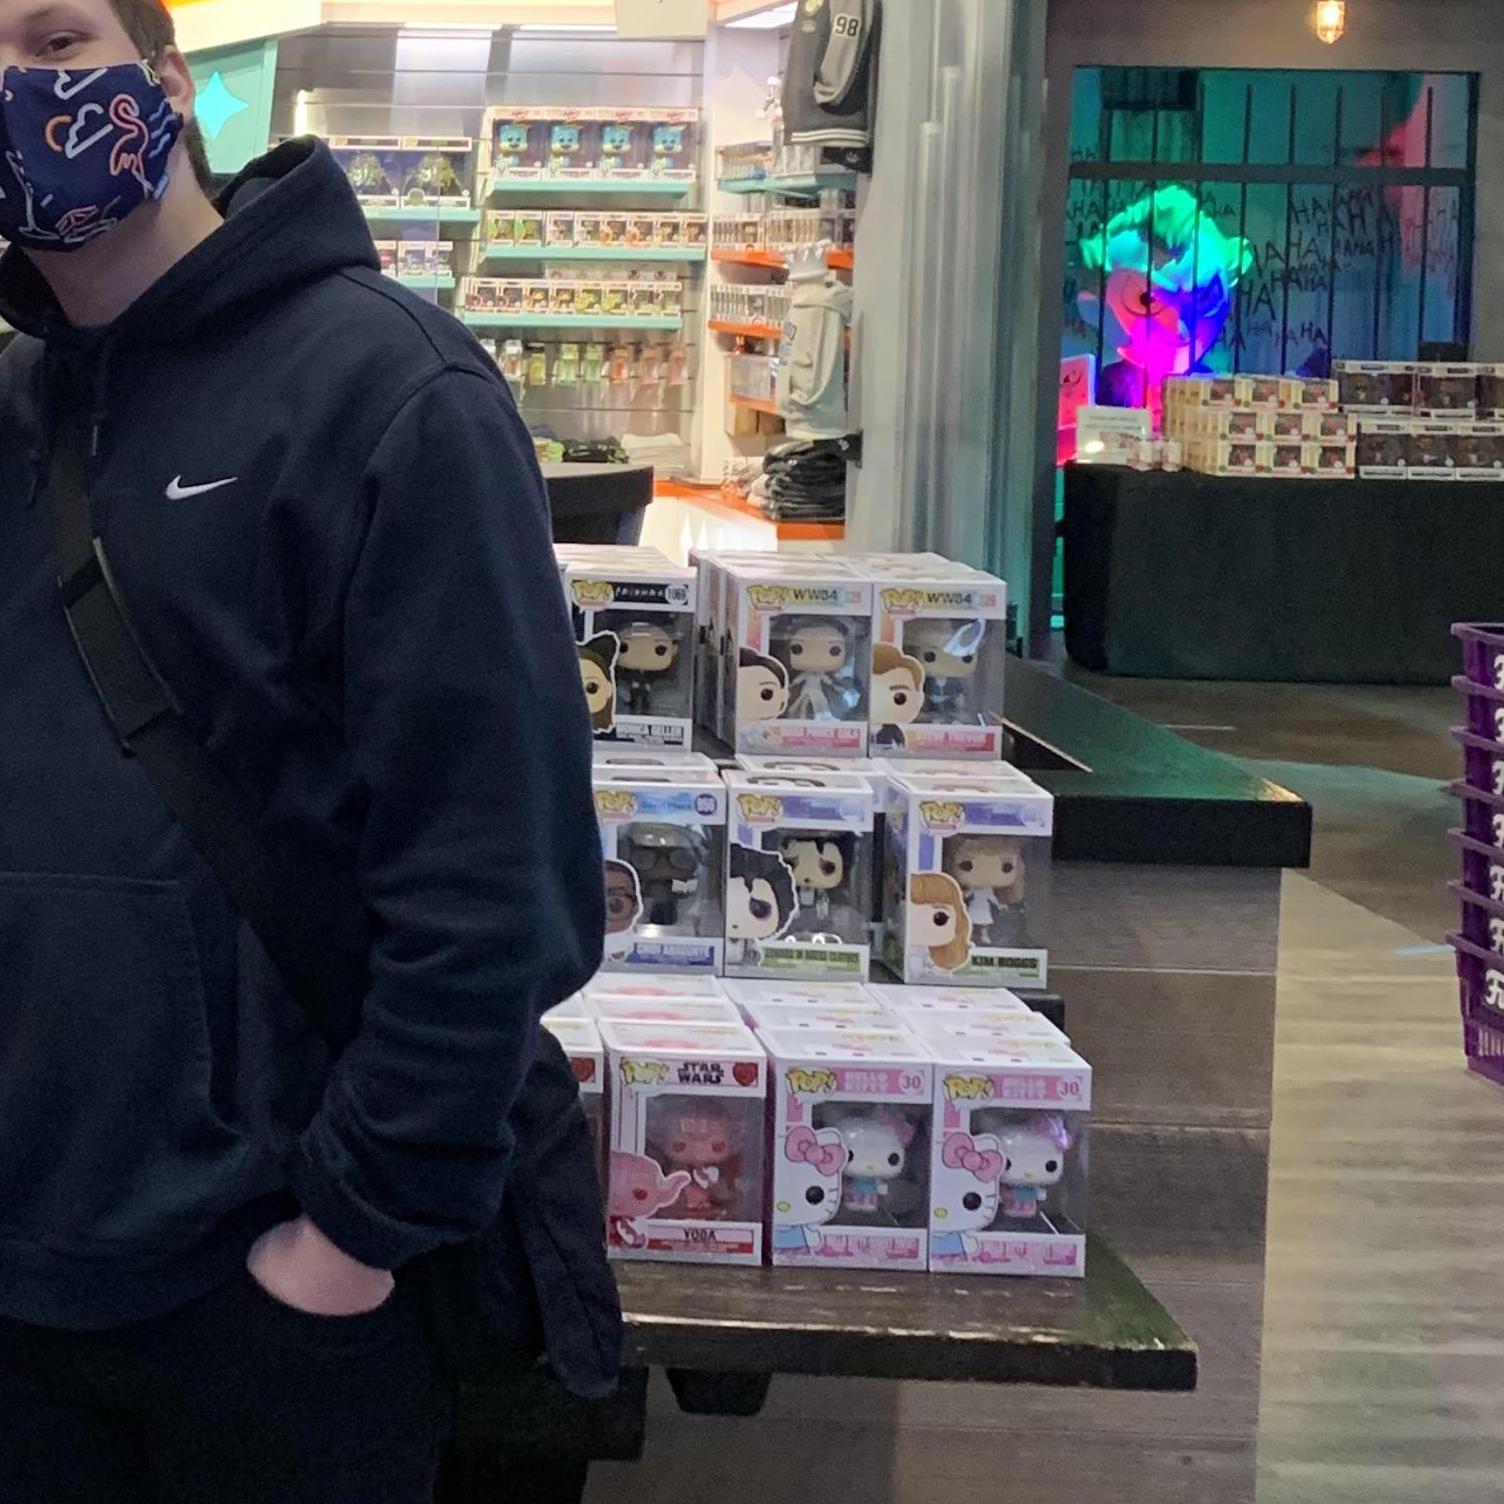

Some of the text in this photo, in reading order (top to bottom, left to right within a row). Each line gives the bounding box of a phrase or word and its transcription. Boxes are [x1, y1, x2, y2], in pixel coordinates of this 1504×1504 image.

[833, 15, 859, 37] 98
[900, 1075, 922, 1090] 30
[1058, 1081, 1080, 1096] 30
[683, 1228, 717, 1242] YODA
